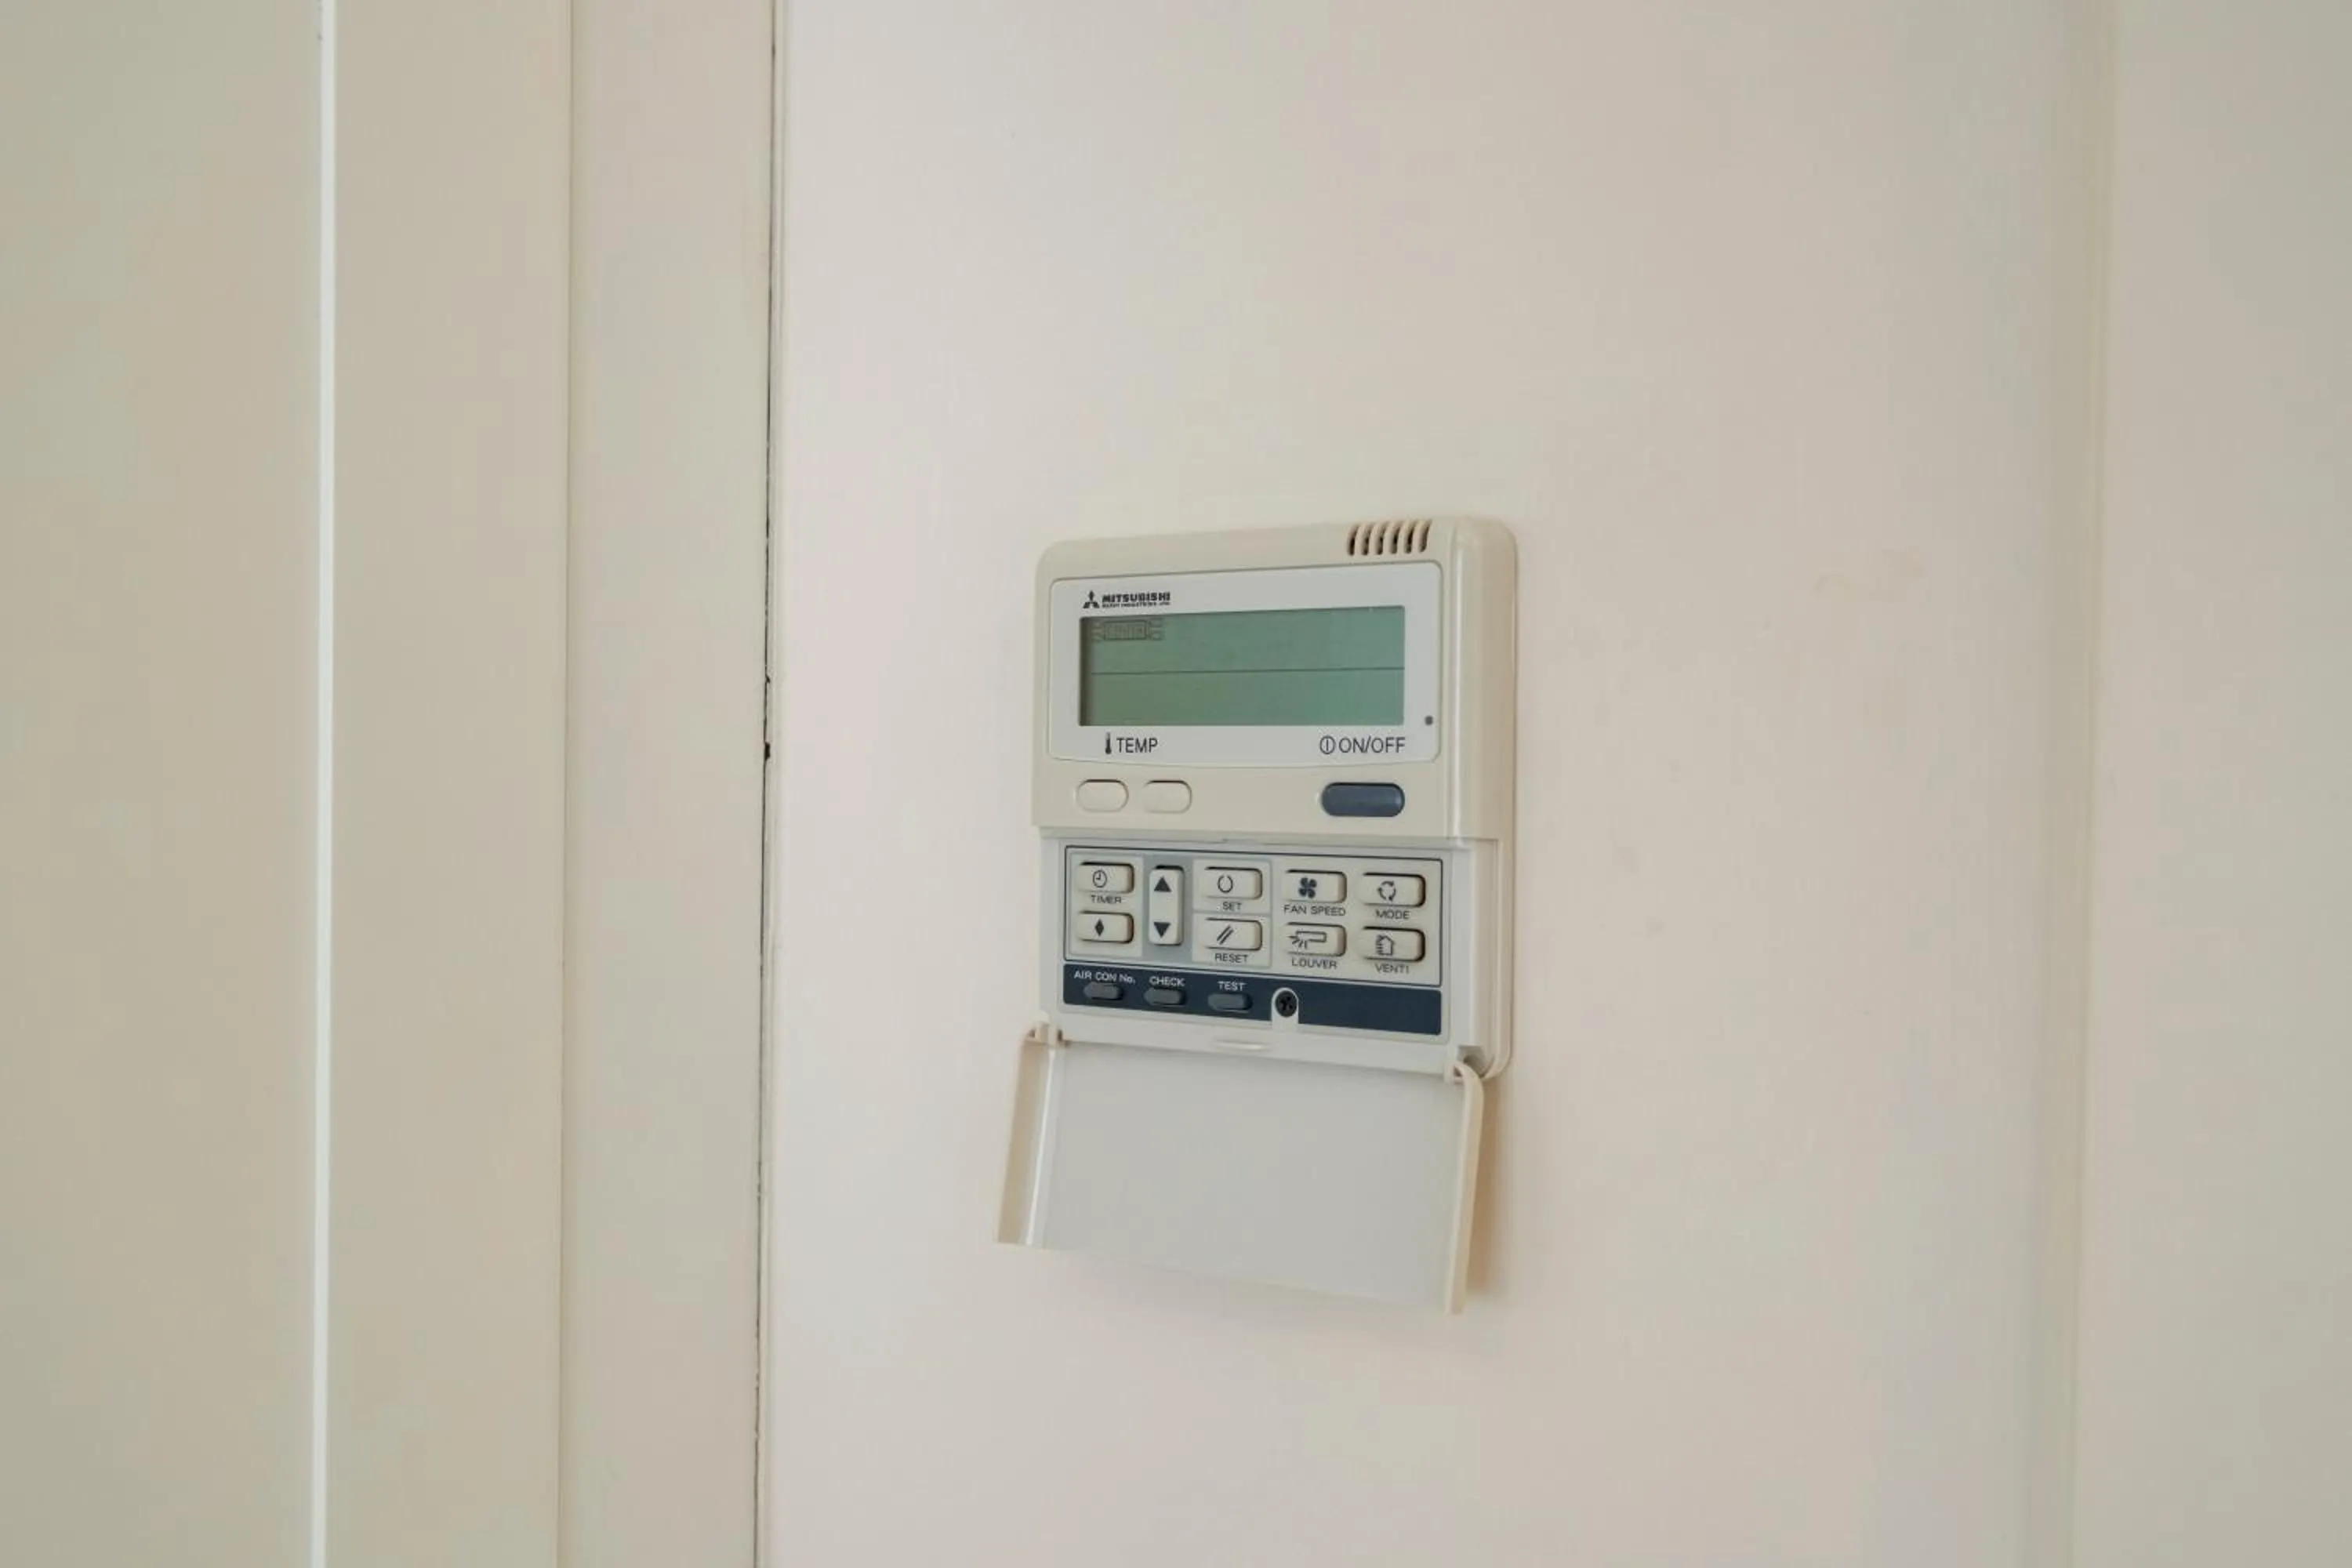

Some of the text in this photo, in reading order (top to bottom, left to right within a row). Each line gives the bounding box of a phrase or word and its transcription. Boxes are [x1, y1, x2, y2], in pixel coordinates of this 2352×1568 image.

[1102, 592, 1171, 602] MITSUBISHI
[1116, 738, 1158, 753] TEMP
[1338, 737, 1406, 753] ON/OFF
[1091, 895, 1122, 904] TIMER
[1222, 902, 1242, 911] SET
[1283, 904, 1346, 916] FAN SPEED
[1375, 909, 1410, 920] MODE
[1214, 953, 1249, 964] RESET
[1291, 958, 1338, 970] LOUVER
[1374, 963, 1410, 974] VENTI
[1073, 970, 1136, 984] AIR CON No.
[1149, 975, 1185, 987] CHECK
[1218, 980, 1247, 991] TEST
